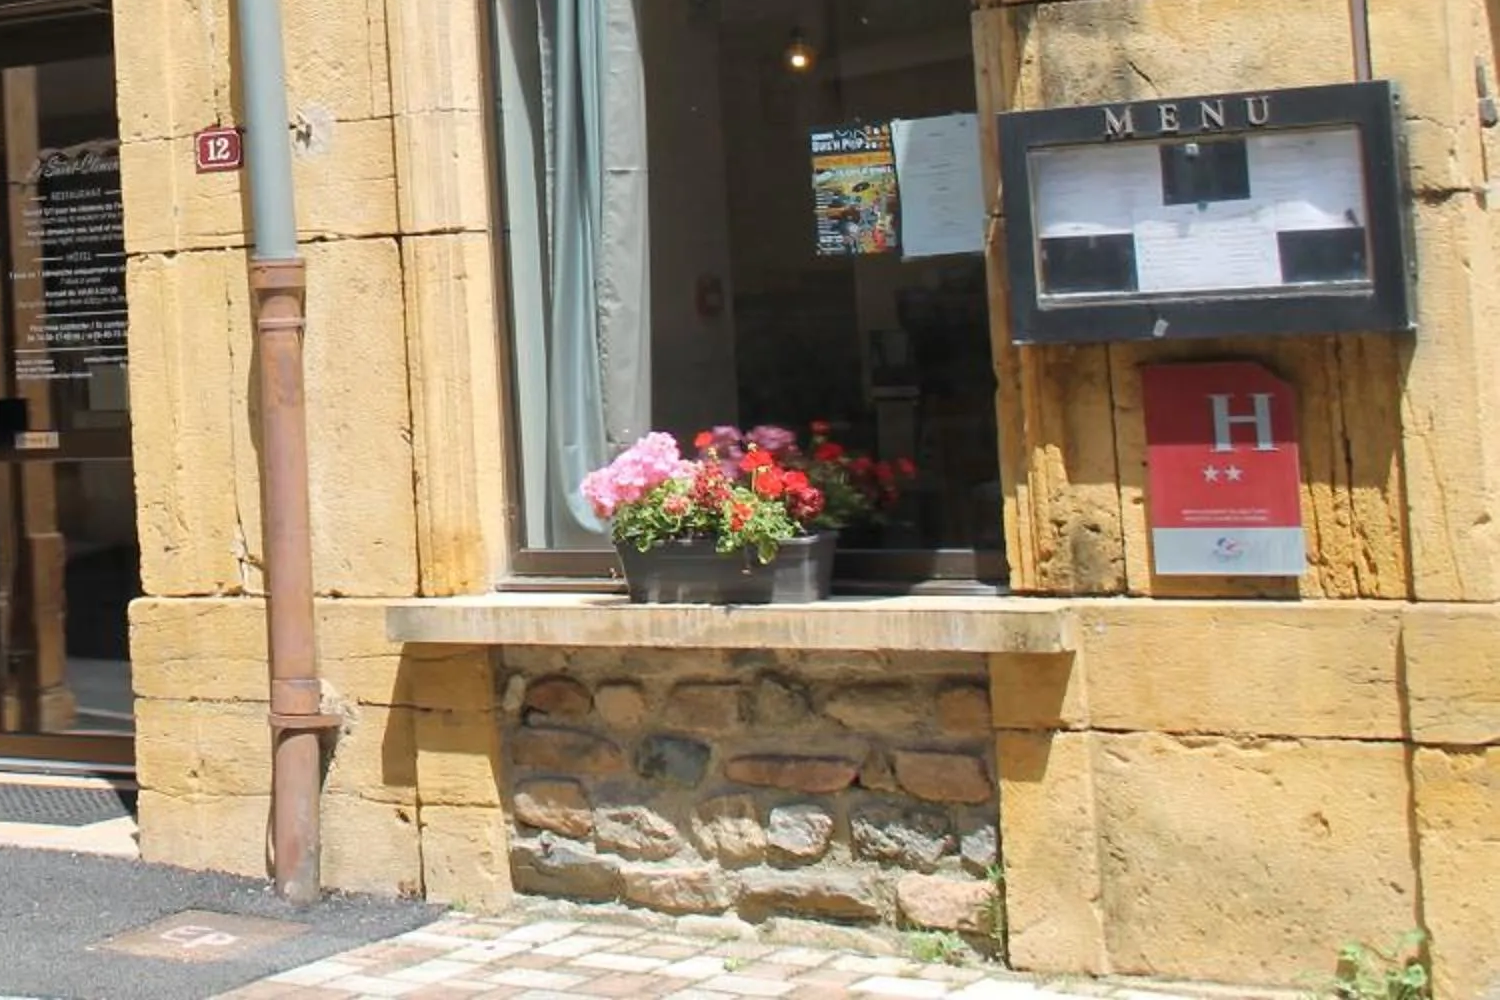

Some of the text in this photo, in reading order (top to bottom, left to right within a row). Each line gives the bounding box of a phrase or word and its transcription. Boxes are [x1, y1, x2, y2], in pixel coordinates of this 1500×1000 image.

[1103, 95, 1274, 141] MENU
[206, 137, 231, 161] 12
[1207, 392, 1280, 452] H
